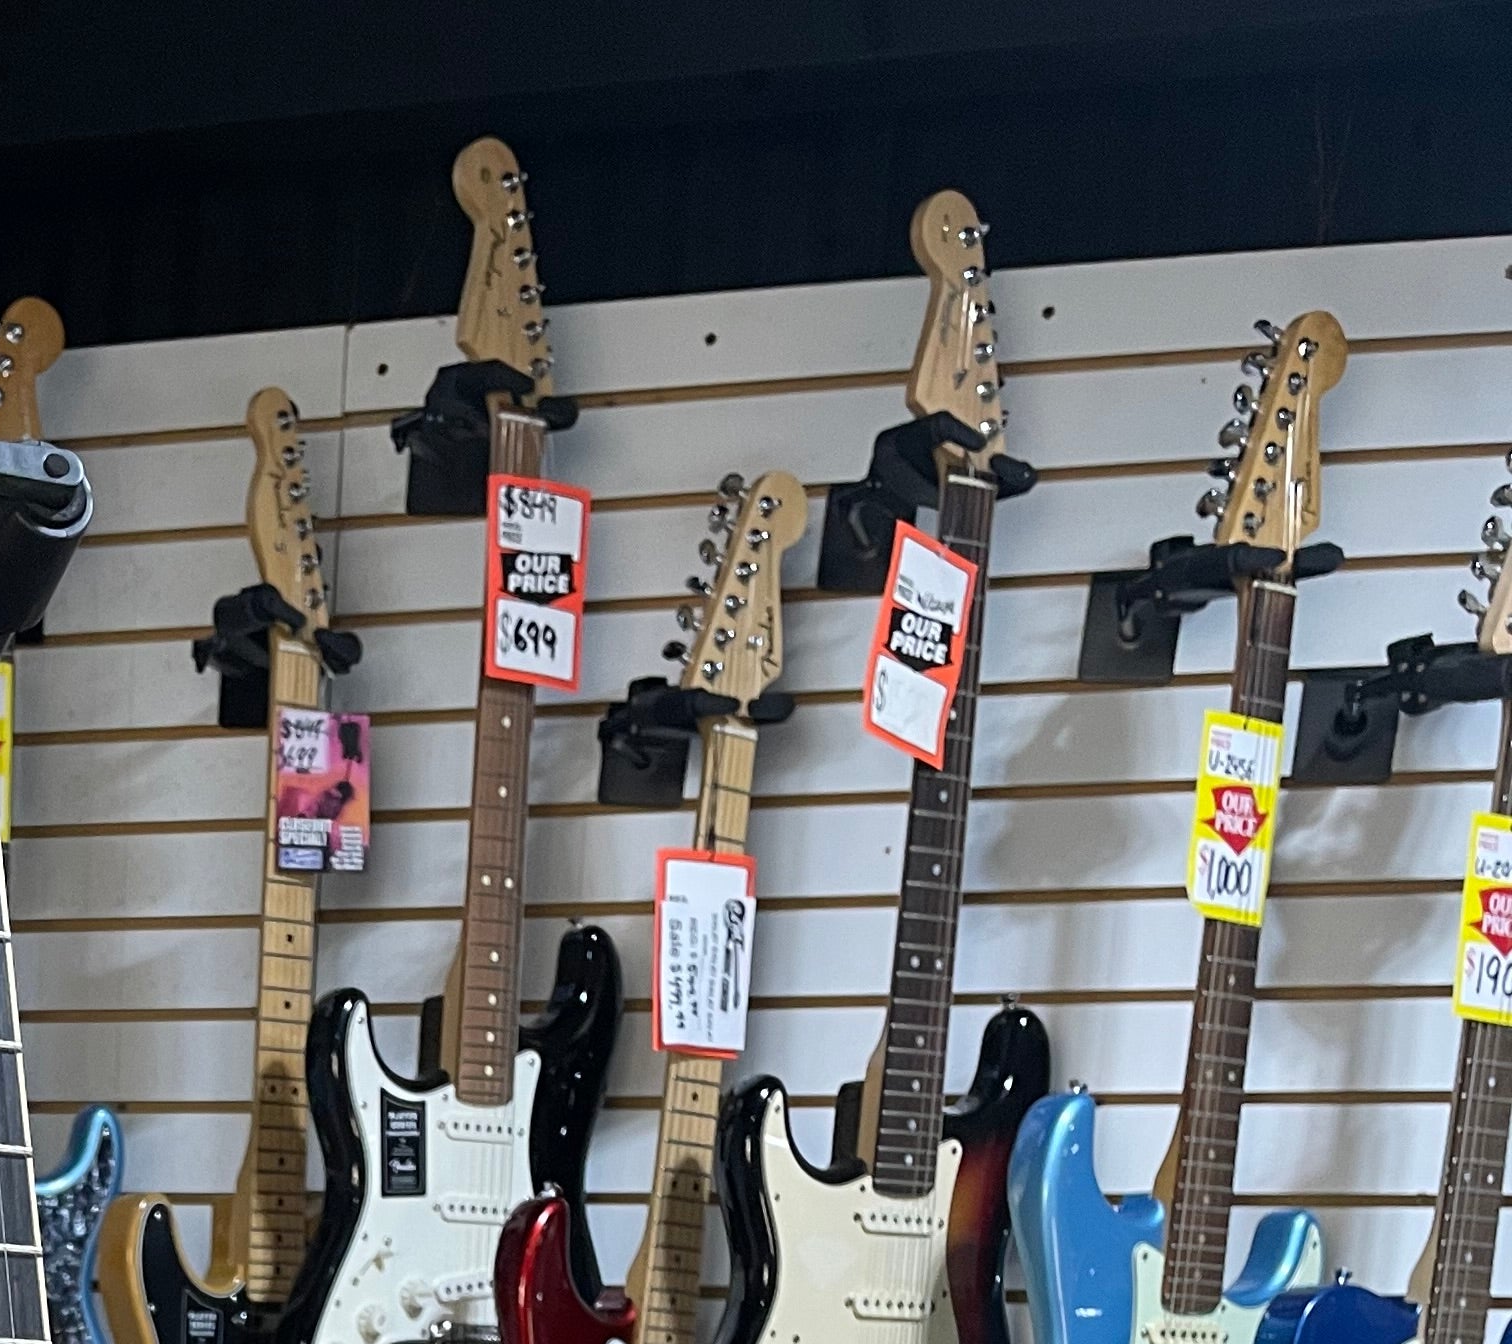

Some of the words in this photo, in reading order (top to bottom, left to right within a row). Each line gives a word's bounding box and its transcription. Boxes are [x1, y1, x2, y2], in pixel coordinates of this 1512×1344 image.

[514, 553, 562, 575] OUR
[507, 573, 570, 595] PRICE
[500, 612, 557, 661] $699
[901, 613, 943, 642] OUR
[890, 630, 948, 665] PRICE
[1221, 790, 1255, 817] OUR
[1215, 810, 1257, 838] PRICE
[1489, 892, 1512, 916] OU
[1482, 911, 1512, 937] PRIC
